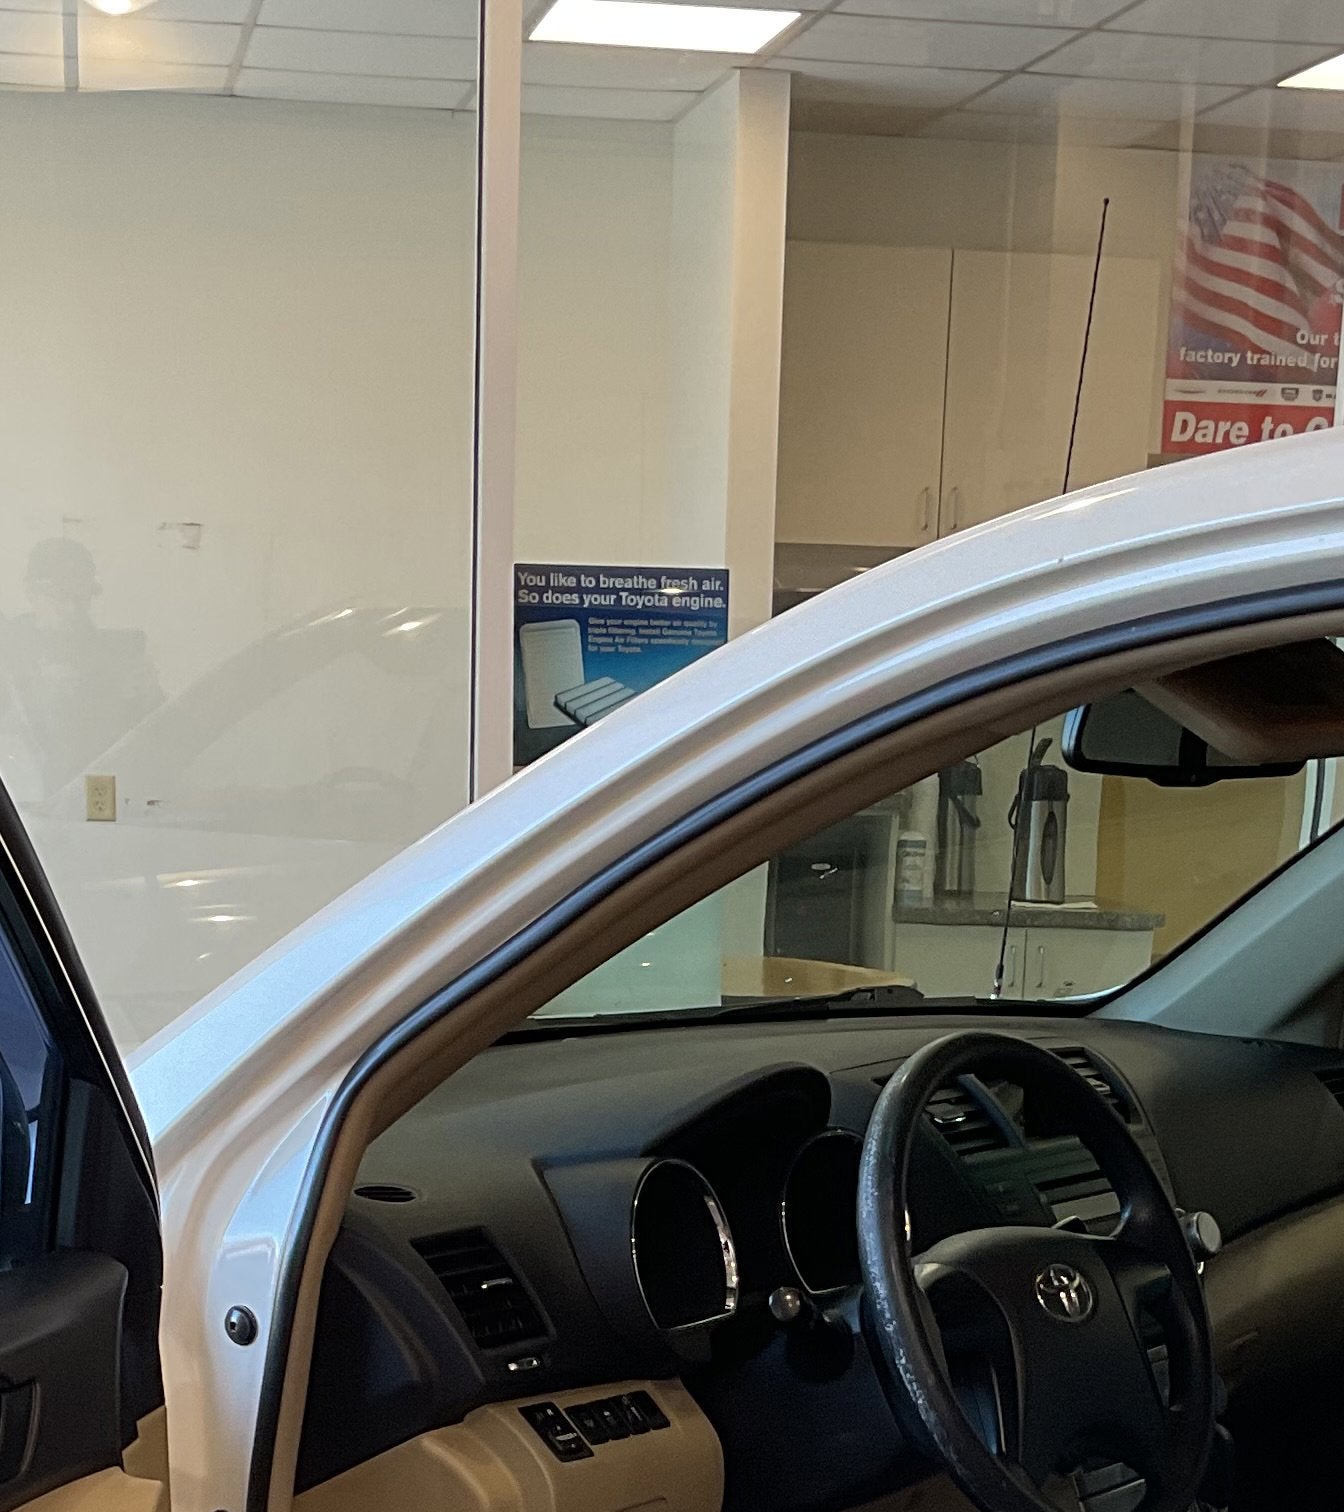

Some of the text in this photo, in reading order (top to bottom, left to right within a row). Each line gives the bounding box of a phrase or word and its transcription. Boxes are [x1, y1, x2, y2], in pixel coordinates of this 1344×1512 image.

[1295, 328, 1328, 346] Our
[1179, 346, 1241, 368] factory
[1246, 349, 1308, 367] trained
[1311, 352, 1338, 370] for
[1170, 410, 1250, 445] Dare
[517, 571, 724, 591] You like to breathe fresh air.
[517, 589, 727, 610] So does your Toyota engine.
